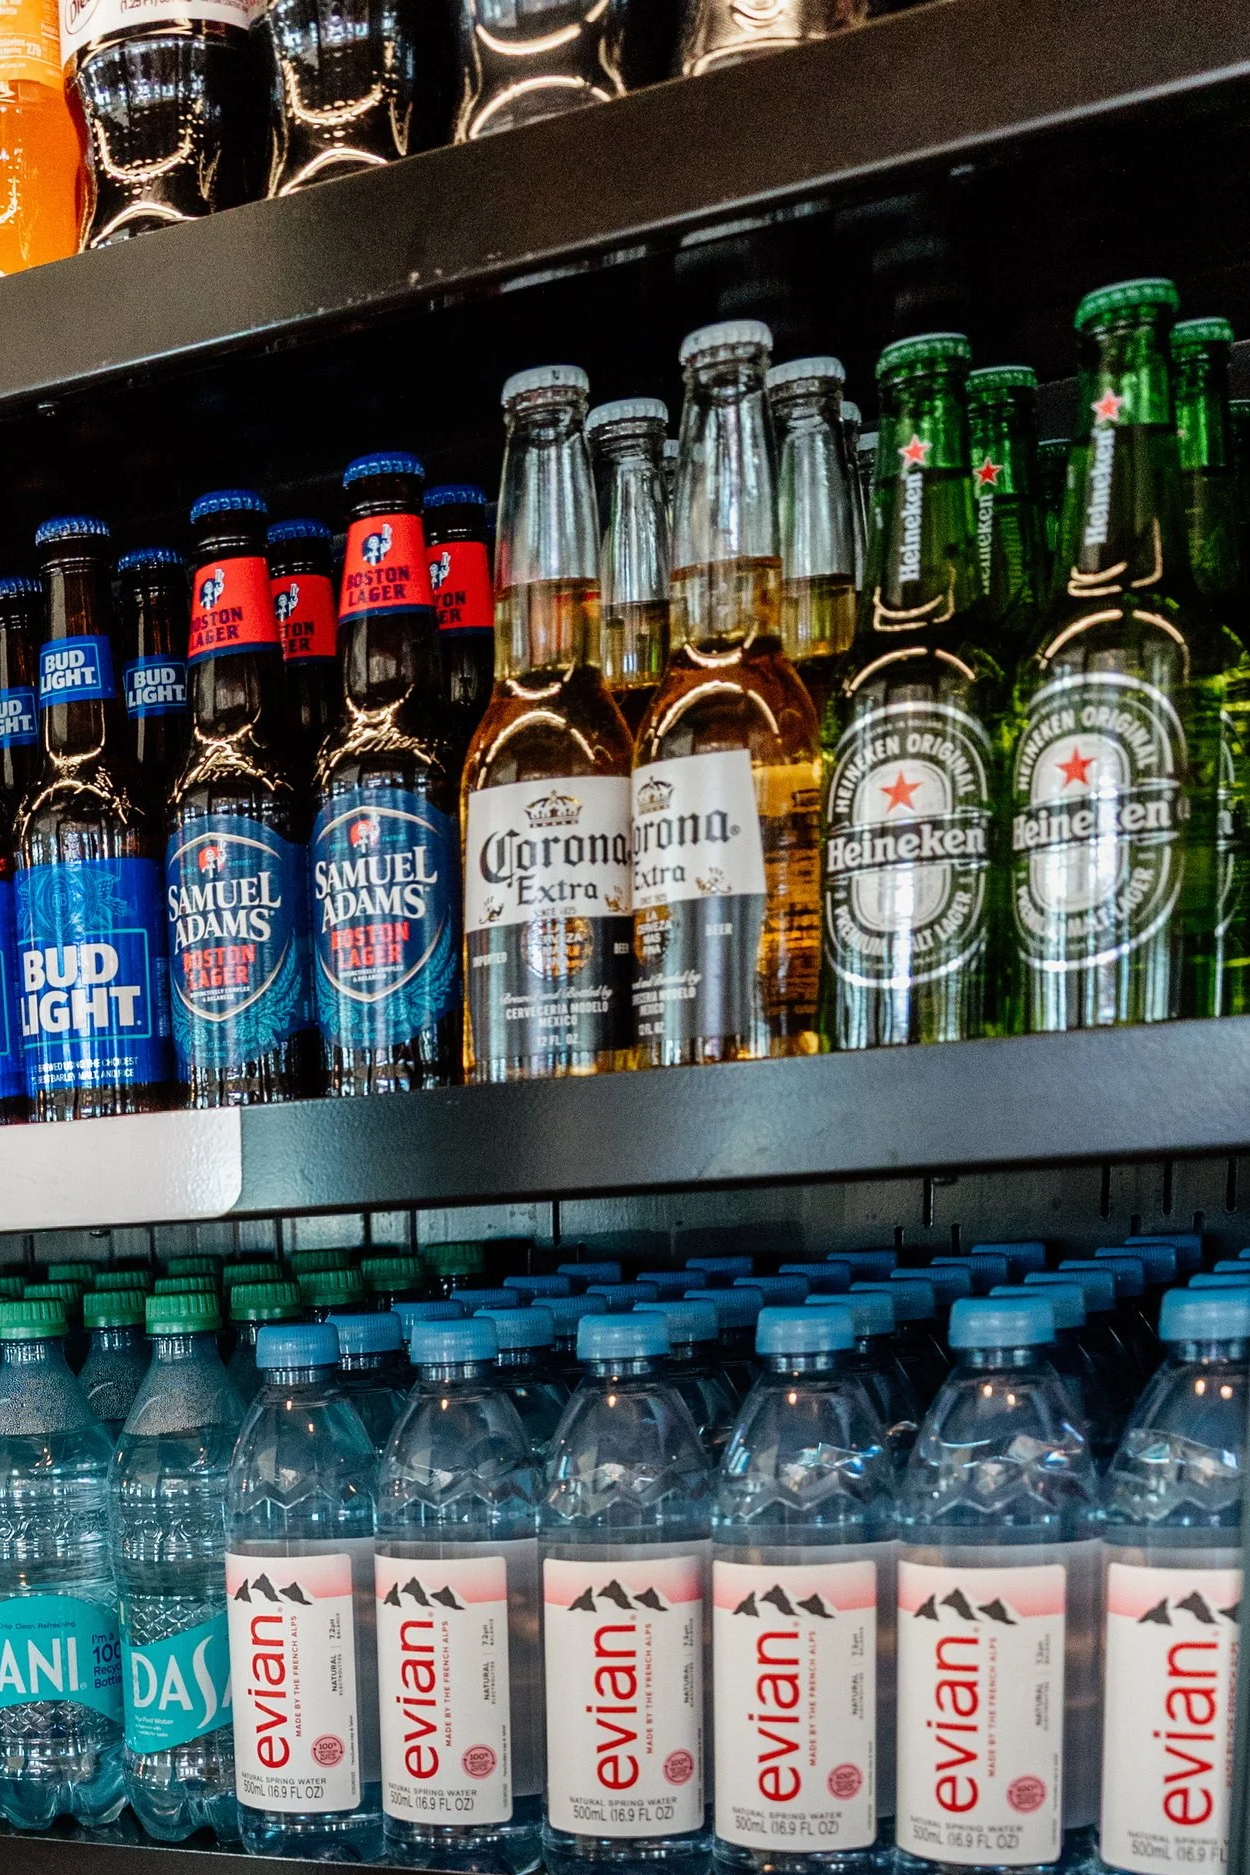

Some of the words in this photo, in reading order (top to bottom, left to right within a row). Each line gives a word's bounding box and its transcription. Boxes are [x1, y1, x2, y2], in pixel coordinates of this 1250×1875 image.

[1085, 428, 1116, 545] Heineken
[899, 472, 923, 583] Heineken
[347, 566, 410, 588] BOSTON
[348, 585, 406, 606] LAGER
[45, 650, 85, 671] BUD
[134, 668, 176, 686] BUD
[906, 732, 976, 797] ORIGINAL
[1013, 801, 1171, 851] Heineken
[480, 829, 629, 887] Corona
[827, 826, 986, 873] Heineken
[315, 846, 438, 899] SAMUEL
[168, 871, 282, 922] SAMUEL
[518, 875, 598, 906] Extra
[321, 884, 426, 933] ADAMS
[175, 909, 271, 954] ADAMS
[331, 921, 409, 950] BOSTON
[23, 942, 119, 993] BUD
[183, 944, 256, 973] BOSTON
[338, 943, 401, 968] LAGER
[189, 965, 249, 991] LAGER
[21, 986, 141, 1037] LIGHT
[538, 1014, 578, 1028] MEXICO
[570, 1001, 608, 1014] MODELO
[292, 1644, 300, 1679] FRENCH
[247, 1614, 291, 1769] evian
[293, 1679, 301, 1696] THE
[294, 1698, 302, 1711] BY
[396, 1619, 439, 1779] evian
[294, 1710, 302, 1737] MADE
[586, 1623, 639, 1790] evian
[748, 1631, 802, 1802] evian
[926, 1635, 980, 1814] evian
[1152, 1640, 1219, 1827] evian
[241, 1772, 264, 1784] NATURAL
[266, 1776, 295, 1785] SPRING
[298, 1777, 327, 1785] WATER
[244, 1781, 266, 1798] 500mL
[268, 1784, 288, 1799] (16.9
[291, 1785, 303, 1798] FL
[305, 1785, 324, 1799] OZ)
[573, 1805, 607, 1822] 500mL
[610, 1806, 635, 1822] (16.9
[638, 1806, 653, 1821] FL
[656, 1805, 674, 1820] OZ)
[608, 1799, 645, 1807] SPRING
[646, 1796, 678, 1806] WATER
